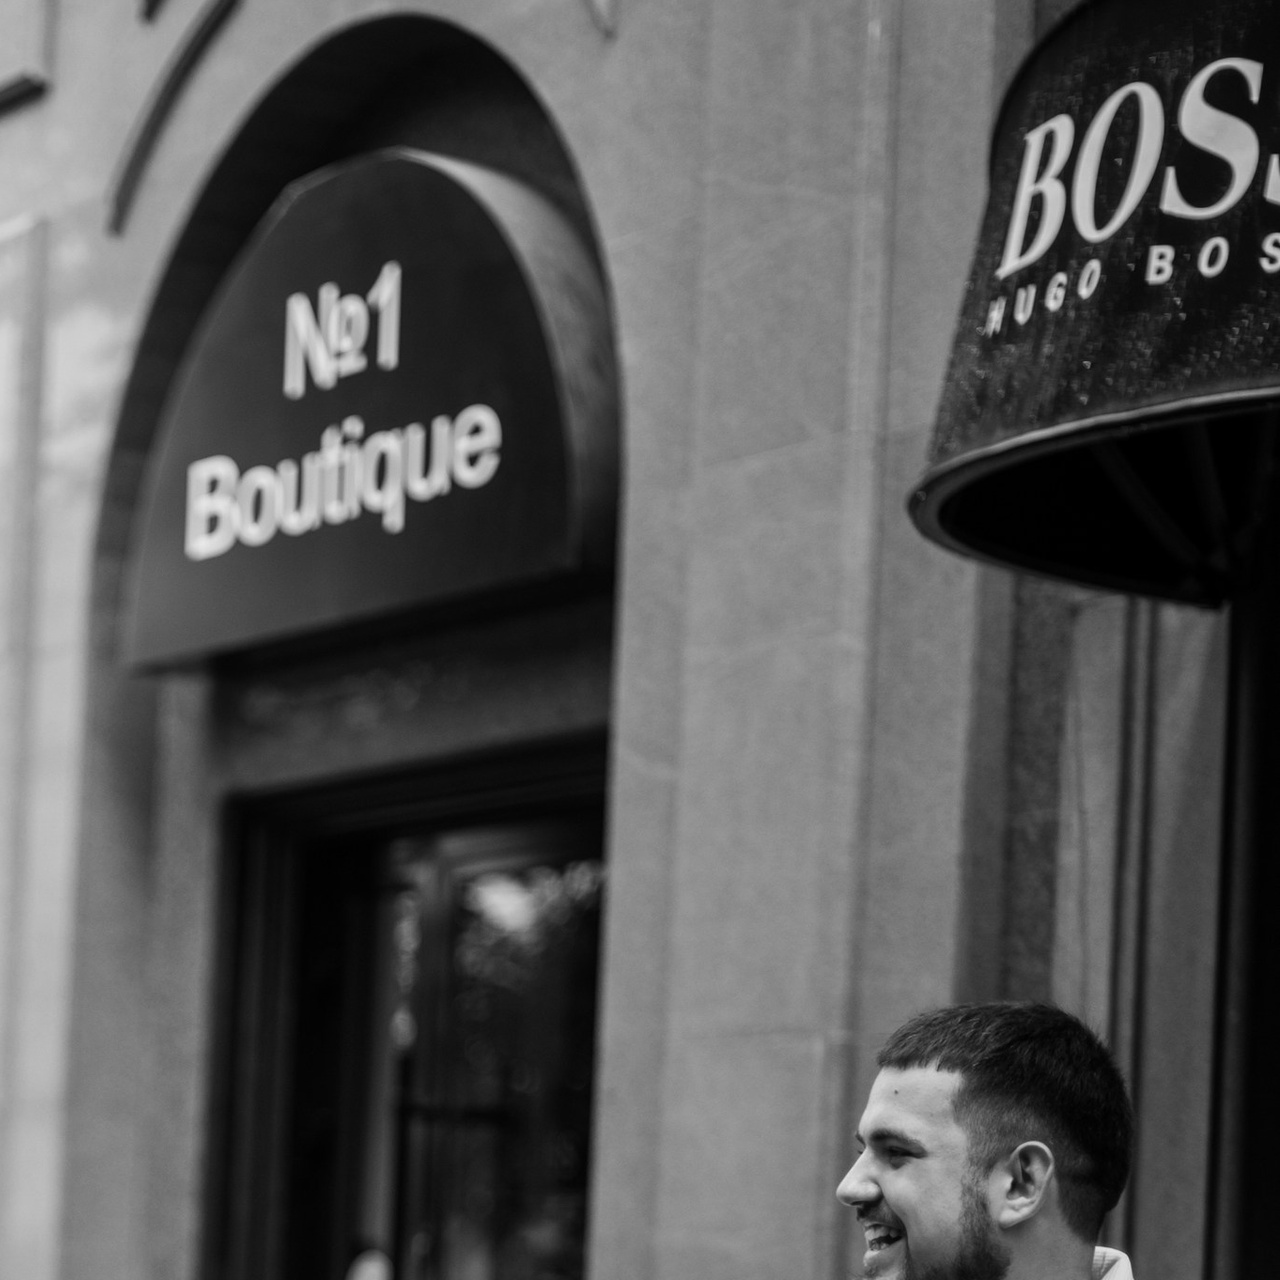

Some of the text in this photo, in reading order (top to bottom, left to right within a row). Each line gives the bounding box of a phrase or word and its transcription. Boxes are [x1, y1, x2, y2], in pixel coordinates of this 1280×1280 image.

[994, 57, 1280, 281] BOS
[984, 258, 1102, 338] HUGO
[184, 403, 503, 561] Boutique
